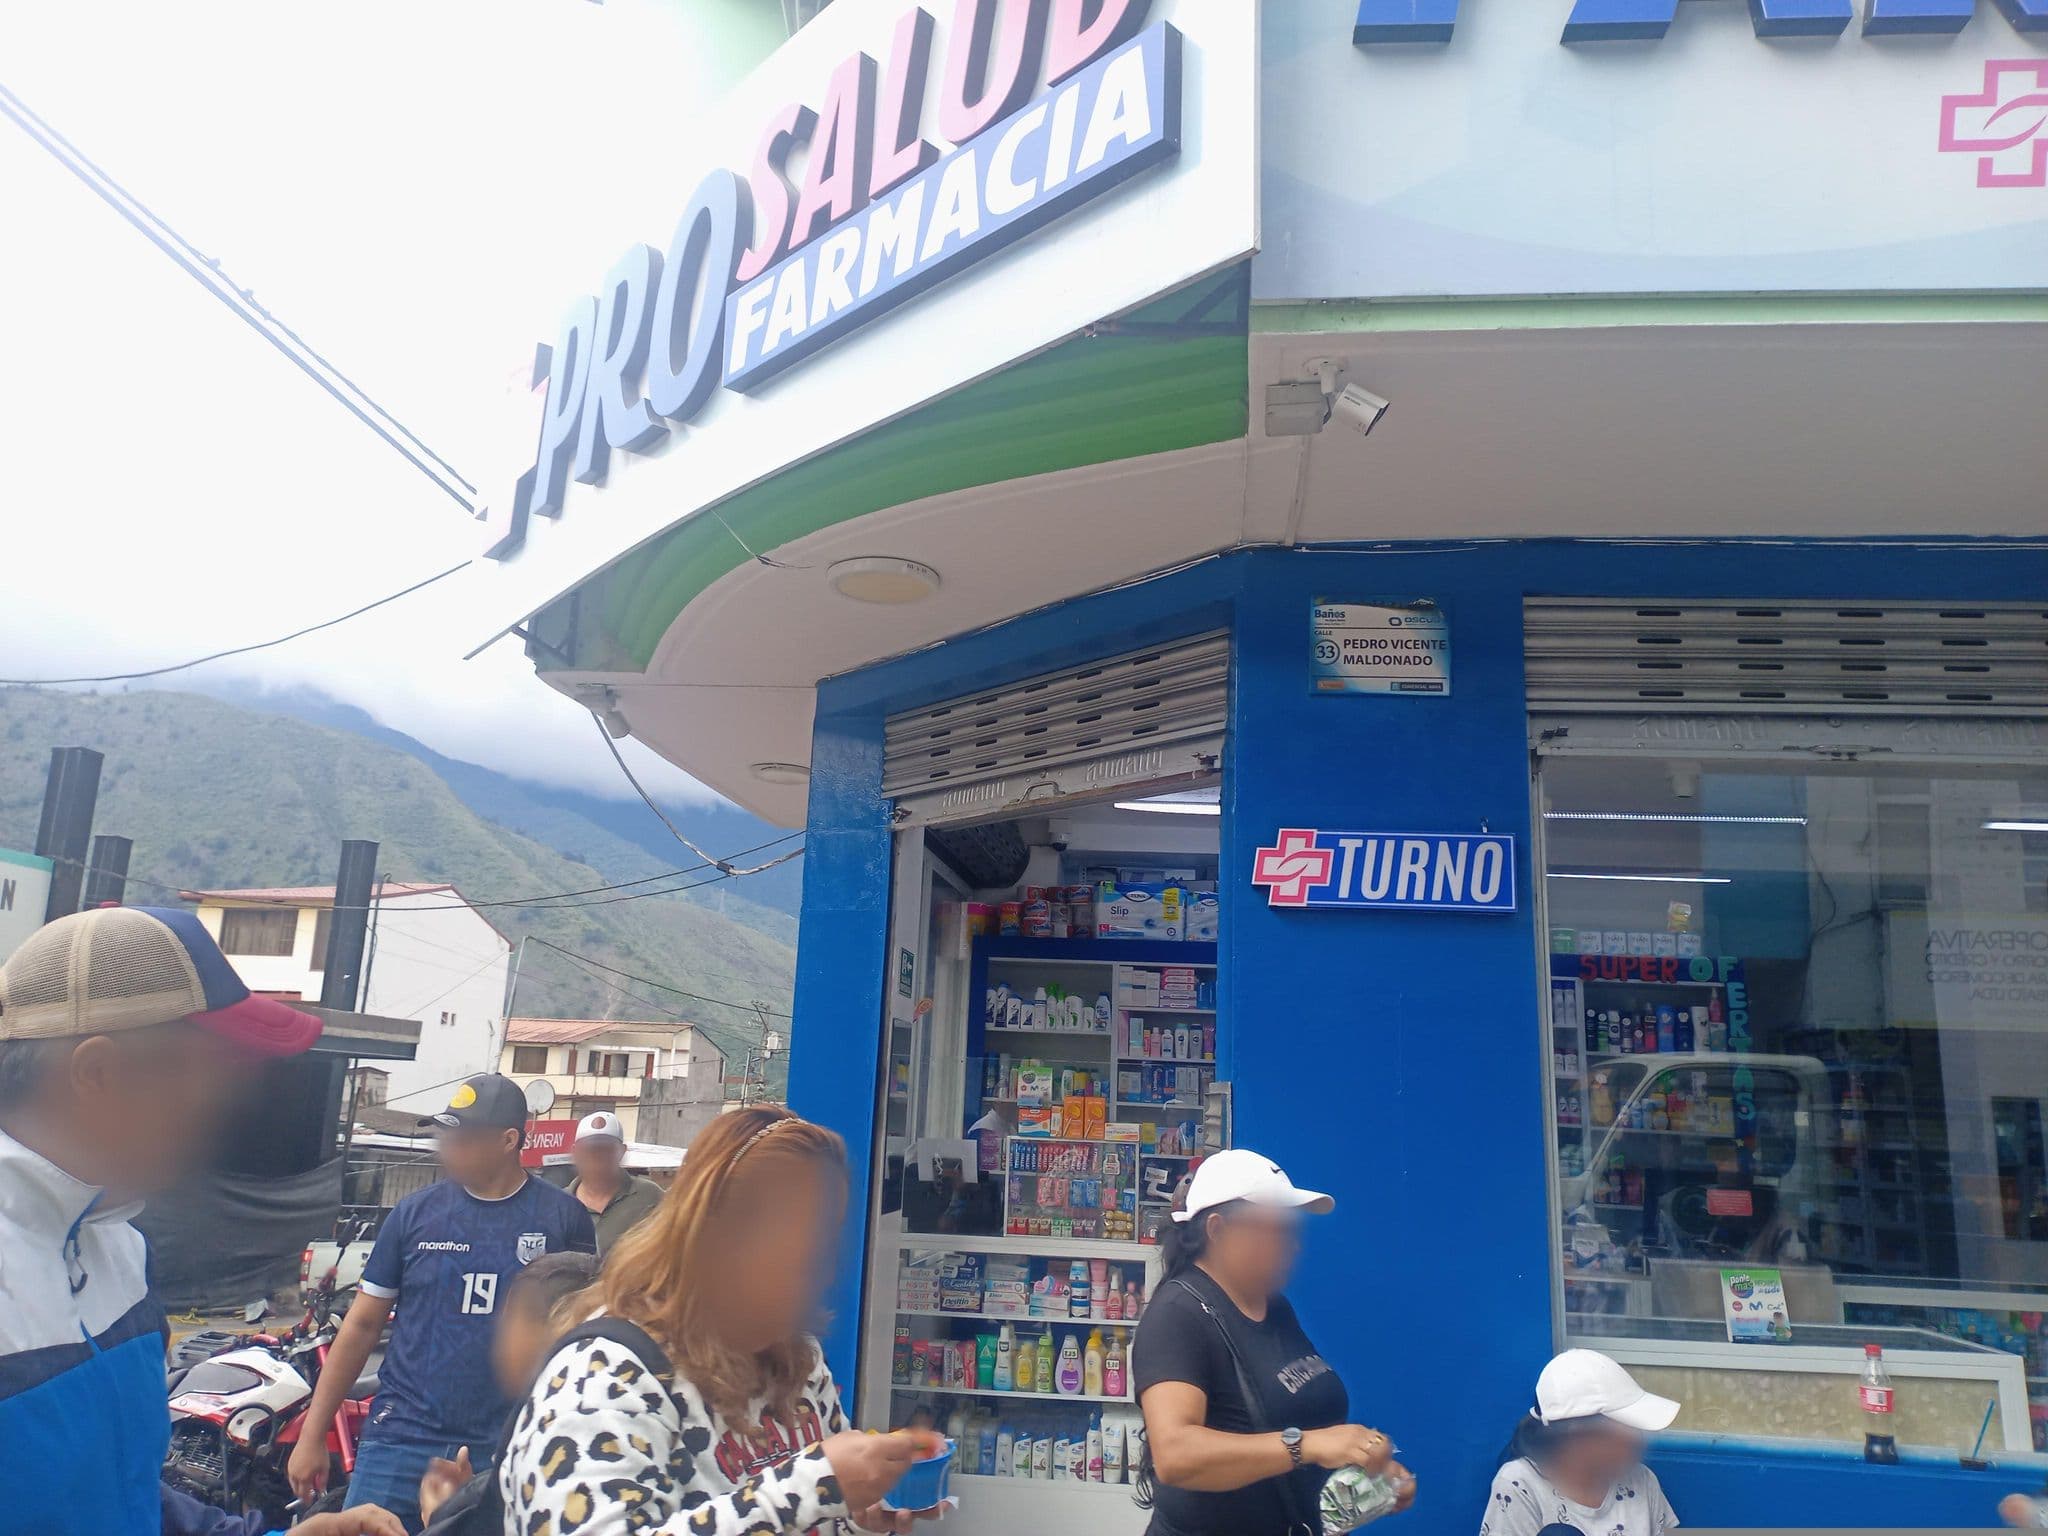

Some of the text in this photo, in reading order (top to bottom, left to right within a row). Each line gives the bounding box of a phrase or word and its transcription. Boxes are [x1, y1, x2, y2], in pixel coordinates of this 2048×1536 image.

[730, 45, 1152, 374] FARMACIA
[1343, 639, 1447, 650] PEDRO VICENTE
[1316, 645, 1336, 659] 33
[1343, 655, 1433, 666] MALDONADO
[1338, 838, 1504, 904] TURNO
[1110, 906, 1129, 917] Slip
[1579, 953, 1679, 984] SUPER
[418, 1241, 470, 1252] marathon
[461, 1272, 498, 1315] 19
